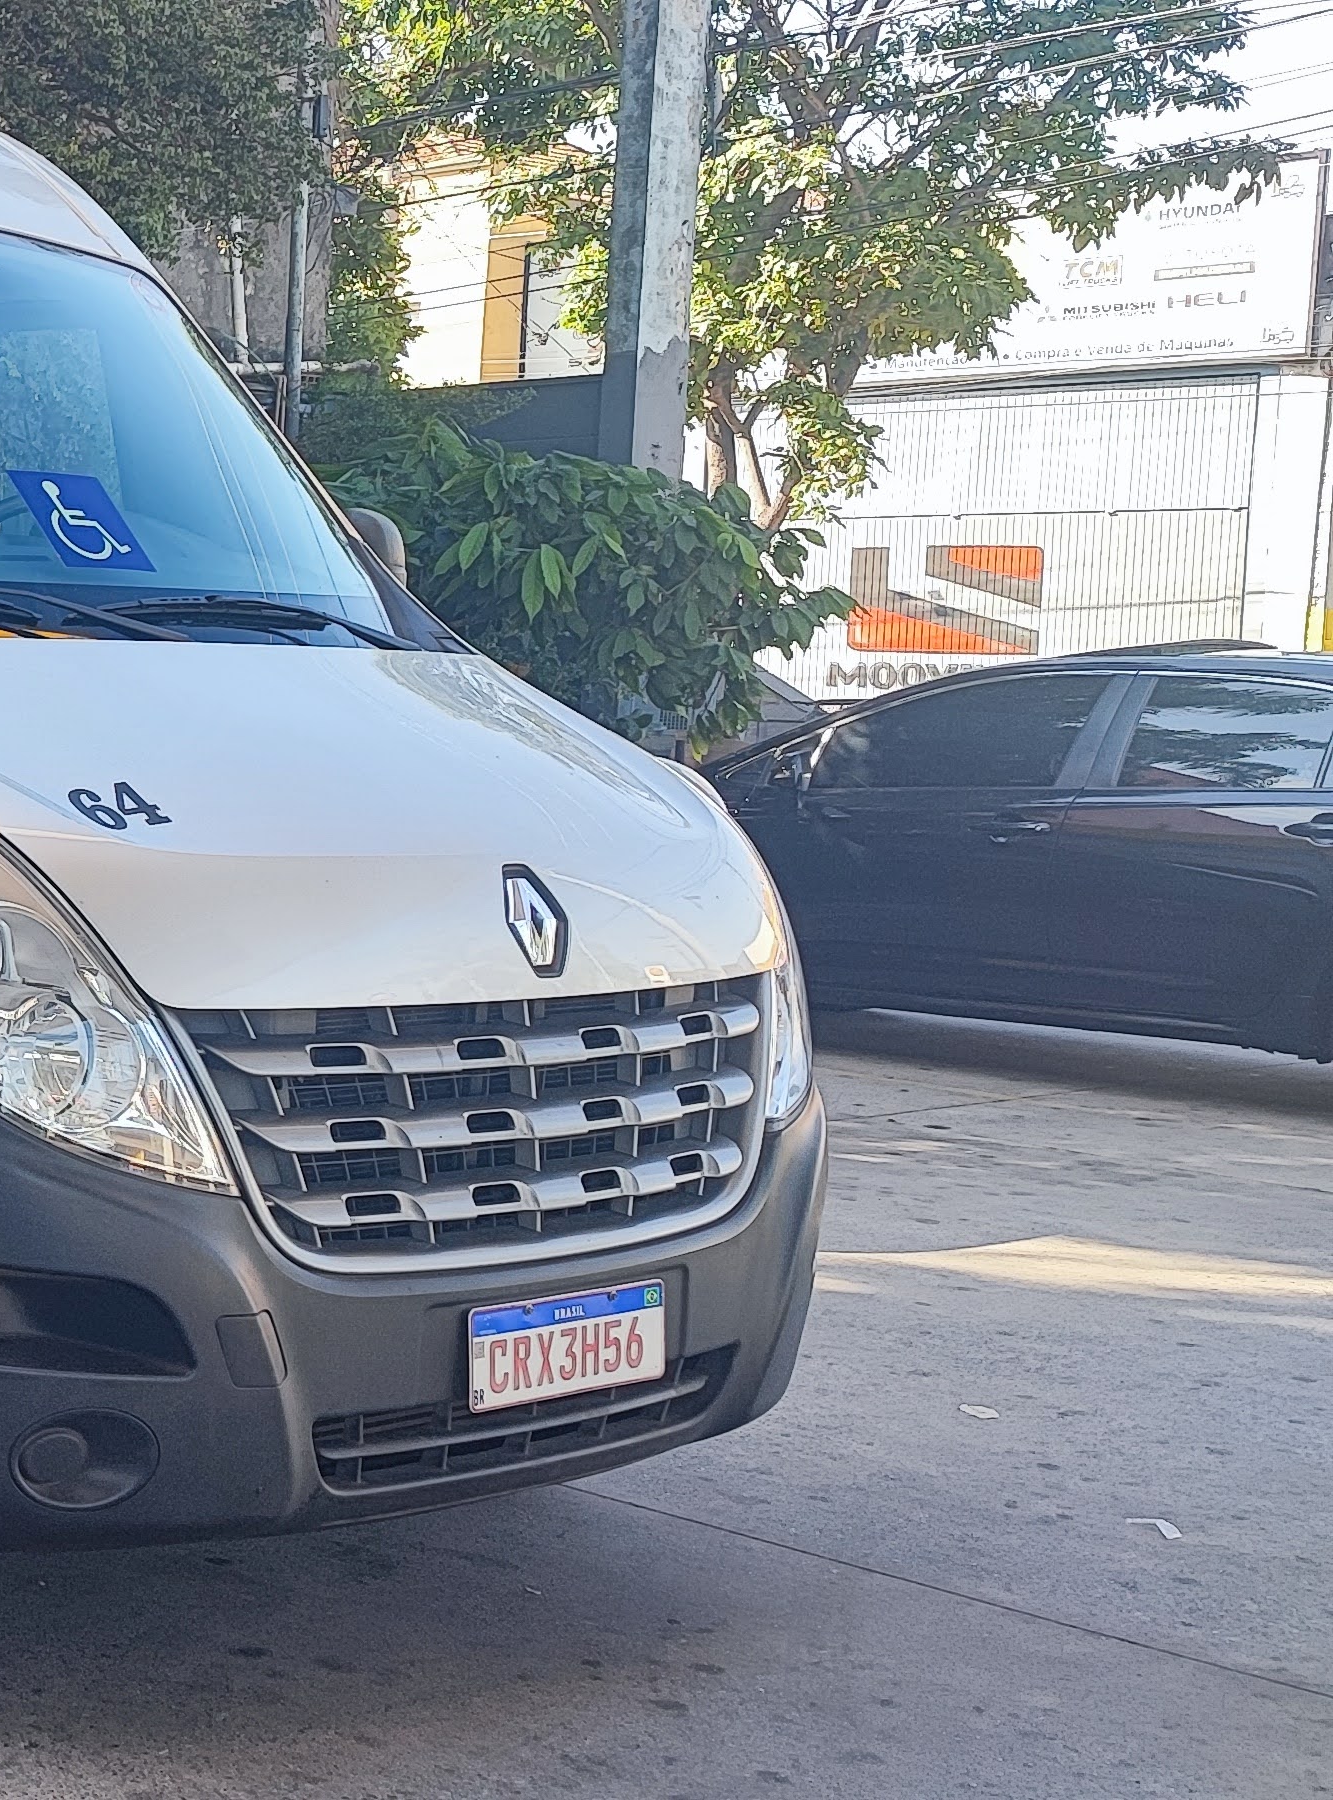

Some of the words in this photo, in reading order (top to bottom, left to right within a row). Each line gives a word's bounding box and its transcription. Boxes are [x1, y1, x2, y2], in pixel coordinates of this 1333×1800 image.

[1160, 203, 1241, 221] HYUNDAI
[1064, 260, 1119, 279] TCM
[1063, 301, 1156, 315] MITSUBISHI
[1015, 346, 1070, 361] Compra
[1137, 341, 1155, 353] de
[67, 781, 173, 831] 64
[554, 1304, 586, 1321] BRASIL
[489, 1316, 644, 1394] CRX3H56
